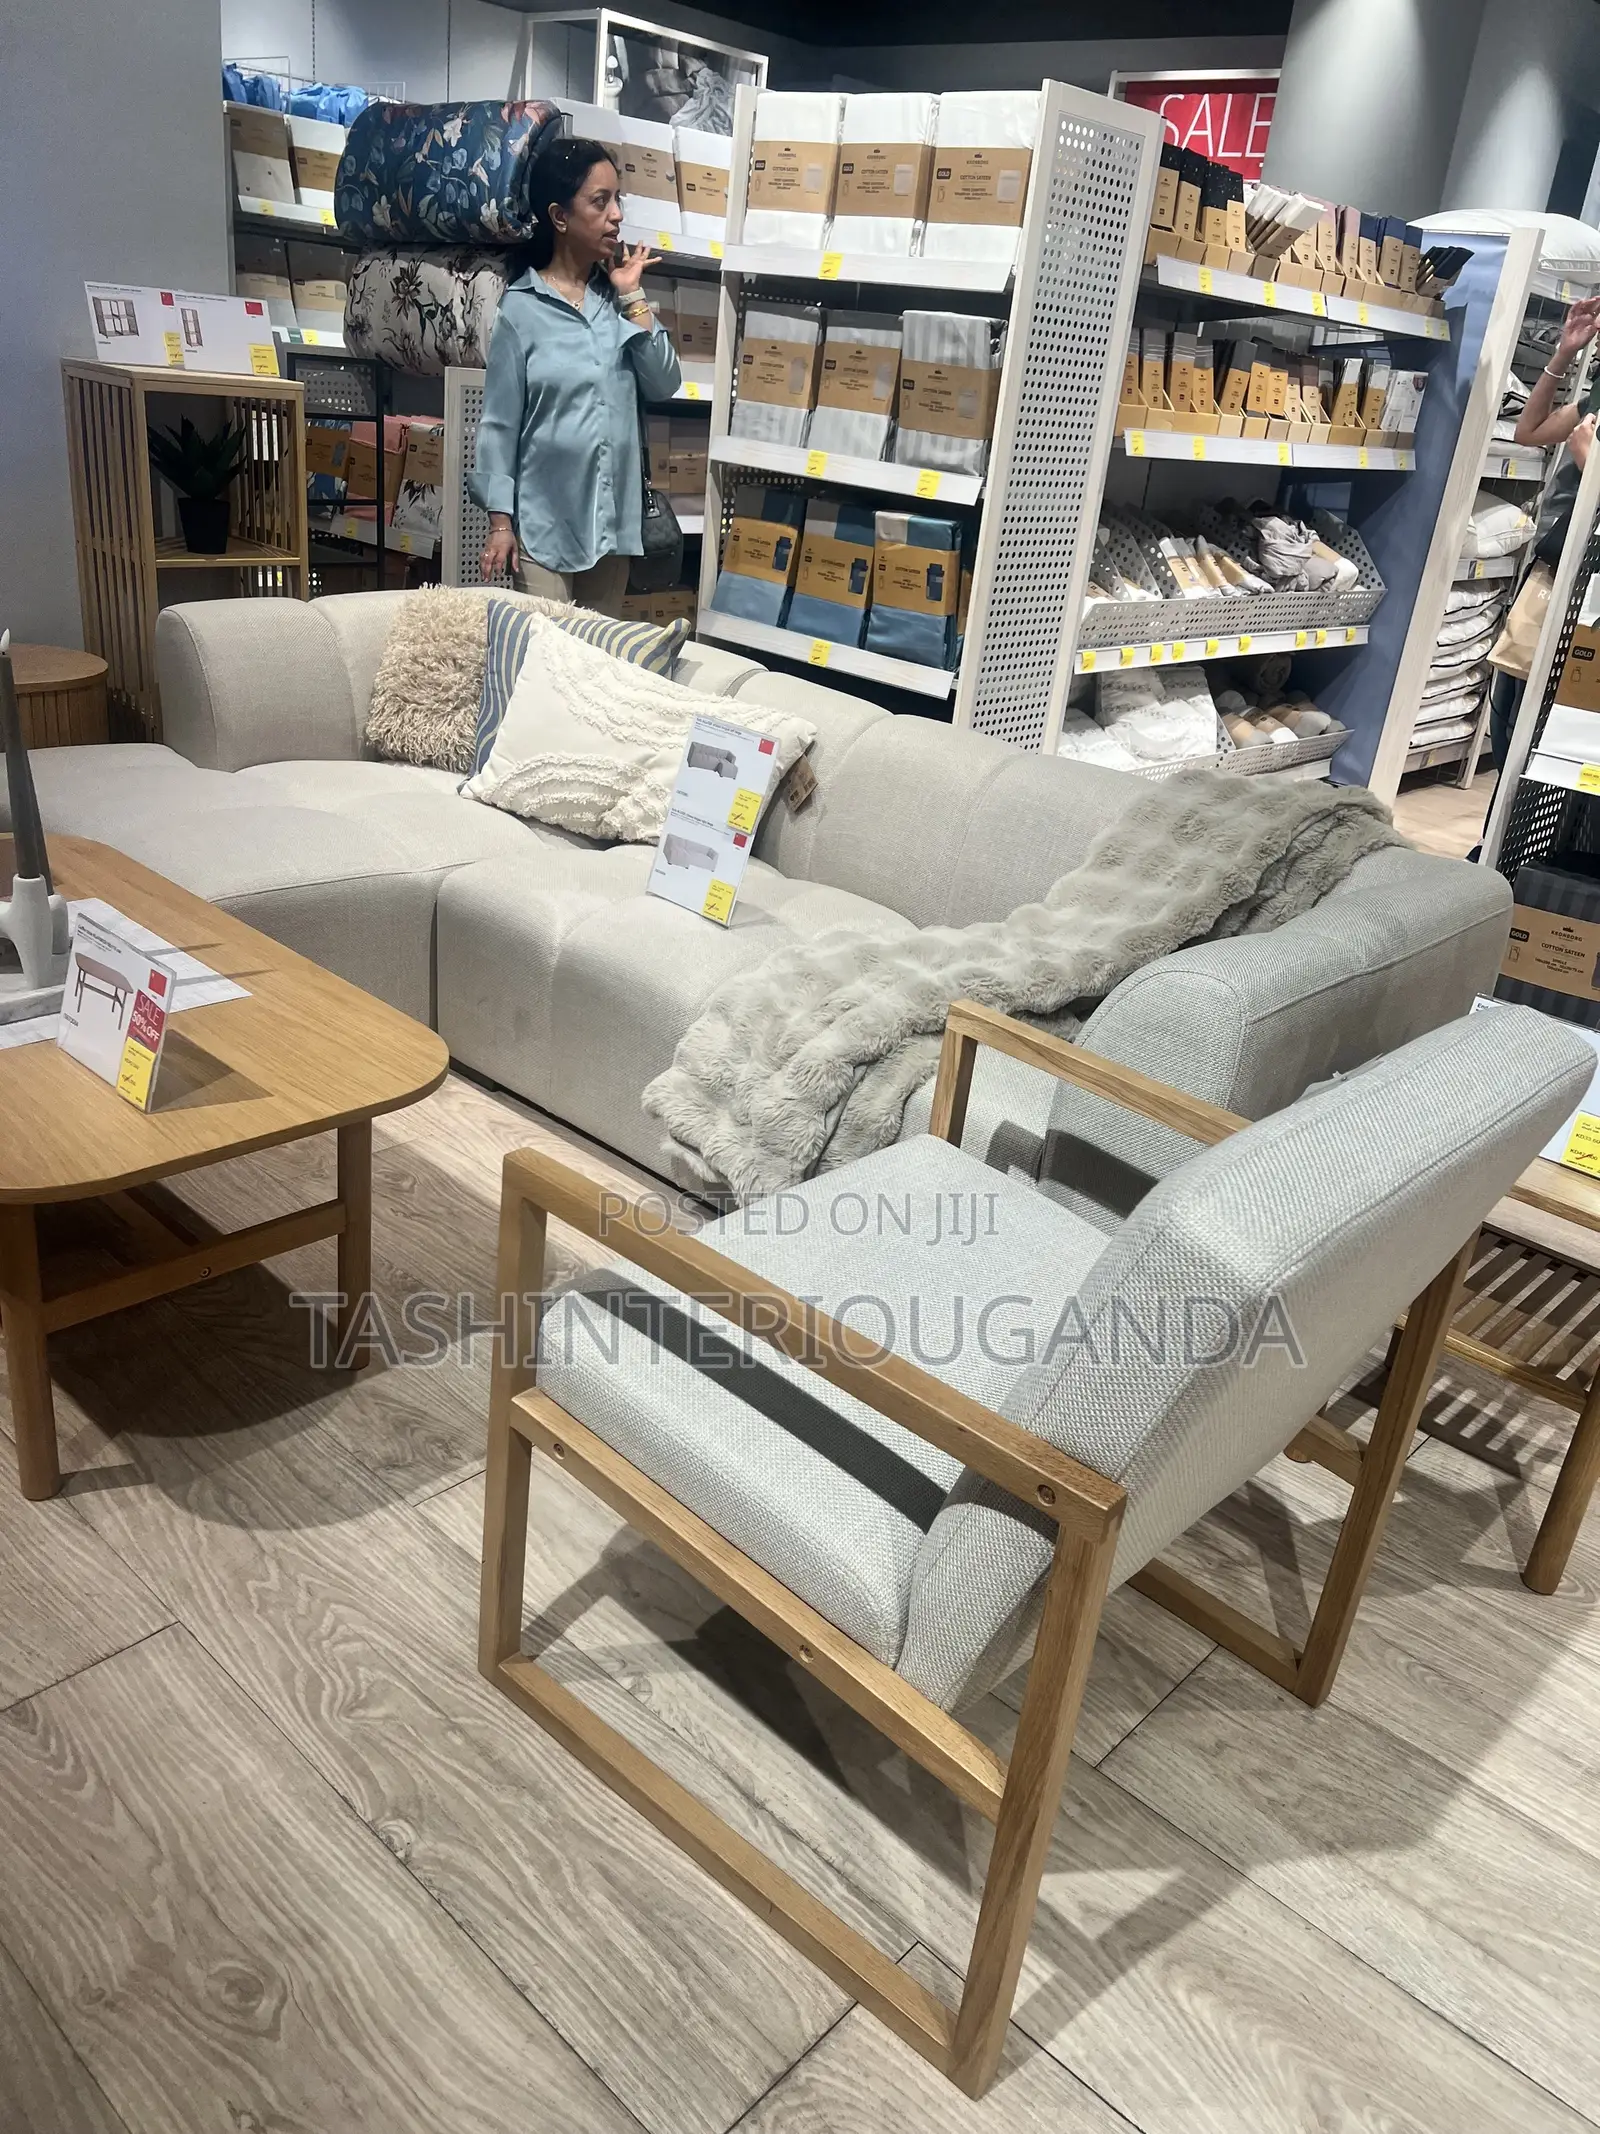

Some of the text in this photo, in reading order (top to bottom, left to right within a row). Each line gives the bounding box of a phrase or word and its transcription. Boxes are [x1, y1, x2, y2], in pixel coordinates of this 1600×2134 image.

[1160, 93, 1277, 157] SALE
[1574, 649, 1593, 658] GOLD
[1511, 930, 1528, 940] GOLD
[1541, 942, 1586, 958] COTTON SATEEN
[138, 994, 162, 1026] SALE
[132, 1010, 147, 1033] 50%
[146, 1027, 160, 1043] OFF
